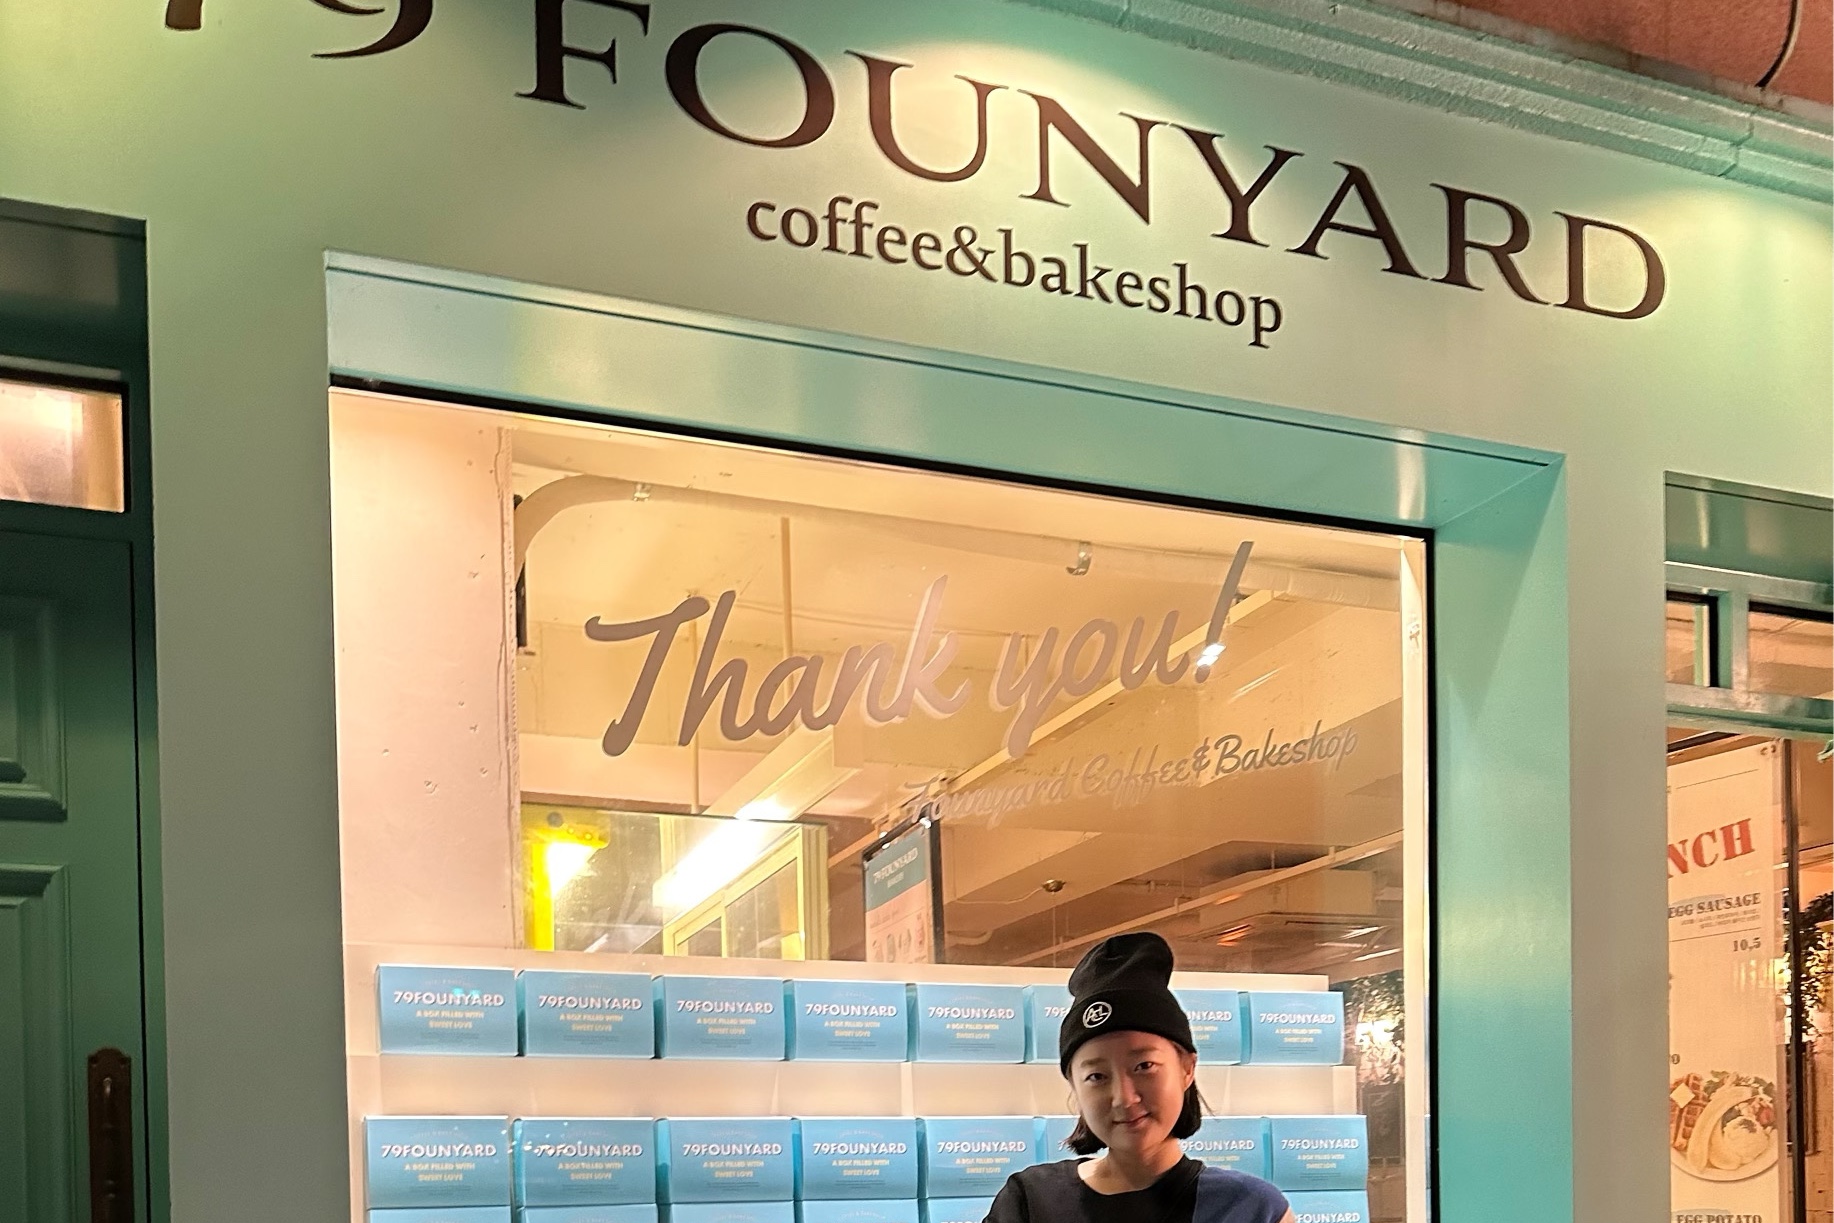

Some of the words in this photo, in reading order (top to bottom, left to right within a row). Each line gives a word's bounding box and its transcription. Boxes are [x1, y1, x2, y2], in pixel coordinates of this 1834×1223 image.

[514, 0, 1666, 320] FOUNYARD
[746, 196, 1284, 348] coffee&bakeshop
[585, 575, 973, 757] Thank
[993, 541, 1254, 757] you!
[1697, 892, 1761, 914] SAUSAGE
[393, 991, 504, 1006] 79FOUNYARD
[538, 994, 642, 1010] 79FOUNYARD
[677, 1000, 773, 1015] 79FOUNYARD
[806, 1003, 895, 1017] 79FOUNYARD
[928, 1007, 1015, 1019] 79FOUNYARD
[1260, 1013, 1336, 1024] 79FOUNYARD
[381, 1144, 496, 1158] 79FOUNYARD
[536, 1143, 642, 1157] 79FOUNYARD
[683, 1143, 781, 1156] 79FOUNYARD
[813, 1143, 906, 1155] 79FOUNYARD
[938, 1141, 1026, 1153] 79FOUNYARD
[1181, 1138, 1254, 1150] 9FOUNYARD
[1281, 1138, 1360, 1150] 79FOUNYARD
[1297, 1213, 1361, 1223] FOUNYARD
